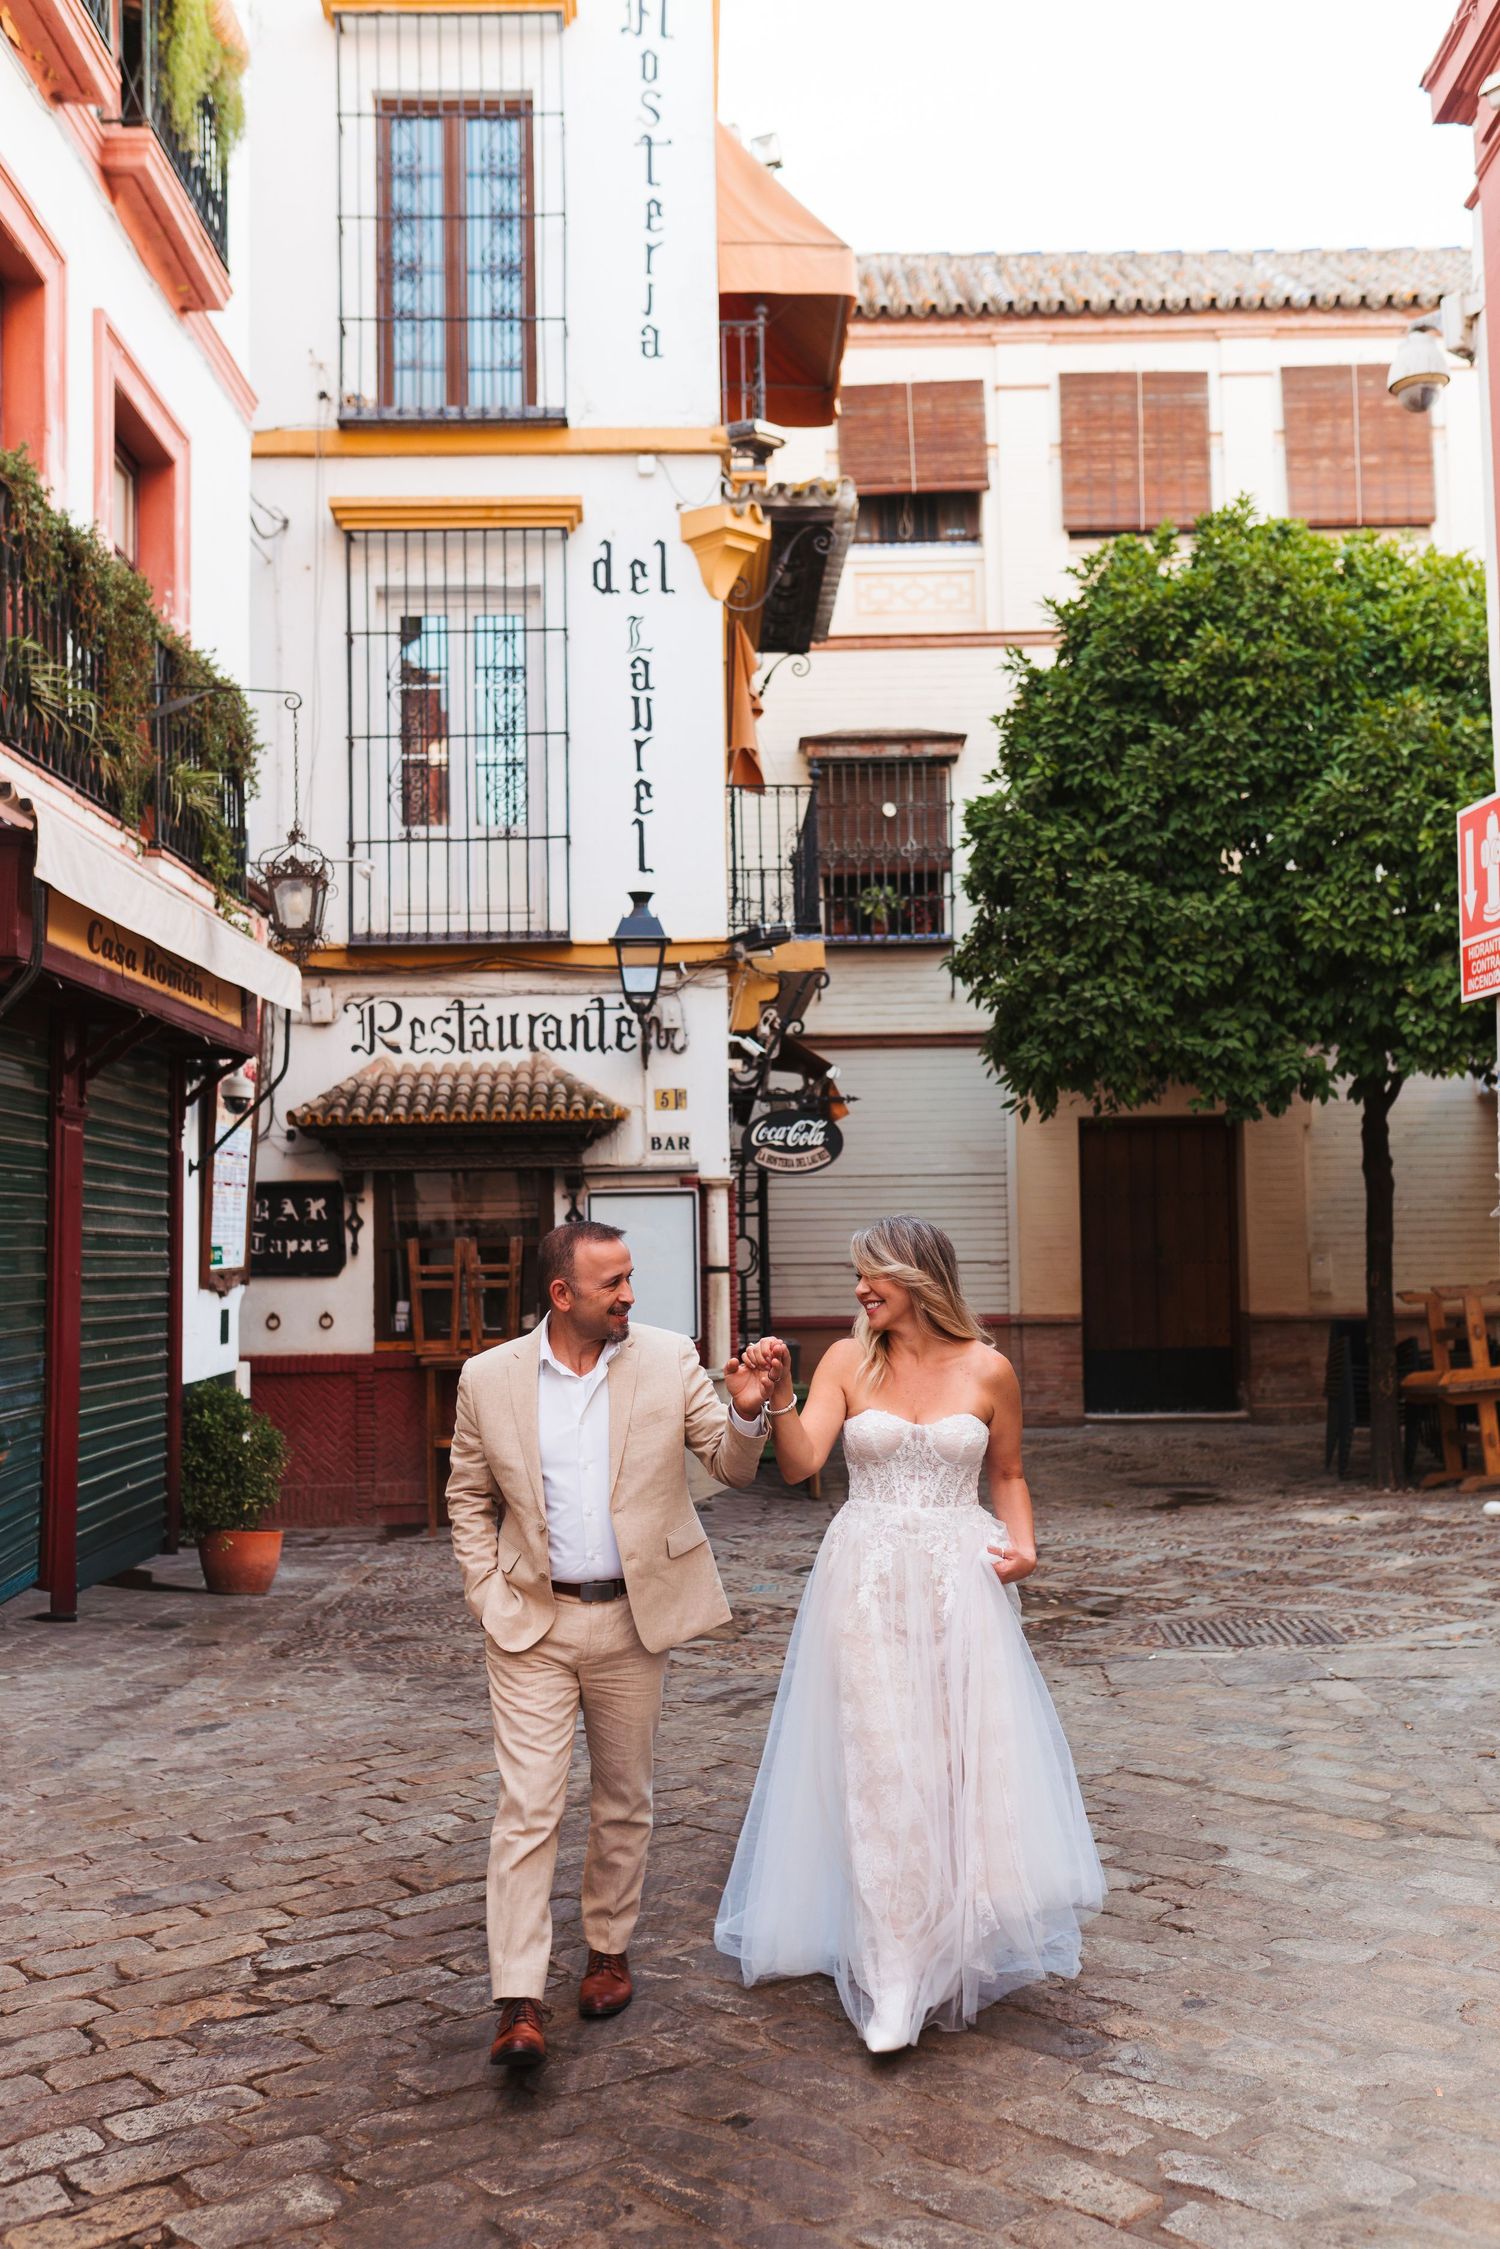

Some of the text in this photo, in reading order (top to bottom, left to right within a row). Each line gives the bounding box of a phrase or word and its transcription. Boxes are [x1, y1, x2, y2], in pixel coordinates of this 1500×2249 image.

[592, 539, 676, 595] del
[626, 614, 656, 874] Laurel
[86, 918, 137, 972] Casa
[1471, 953, 1500, 975] CONTRA
[343, 996, 638, 1056] Restaurante
[660, 1091, 670, 1108] 5
[650, 1135, 690, 1151] BAR
[750, 1119, 829, 1147] Coca-Cola
[253, 1197, 328, 1223] BAR
[250, 1232, 330, 1260] Tapas
